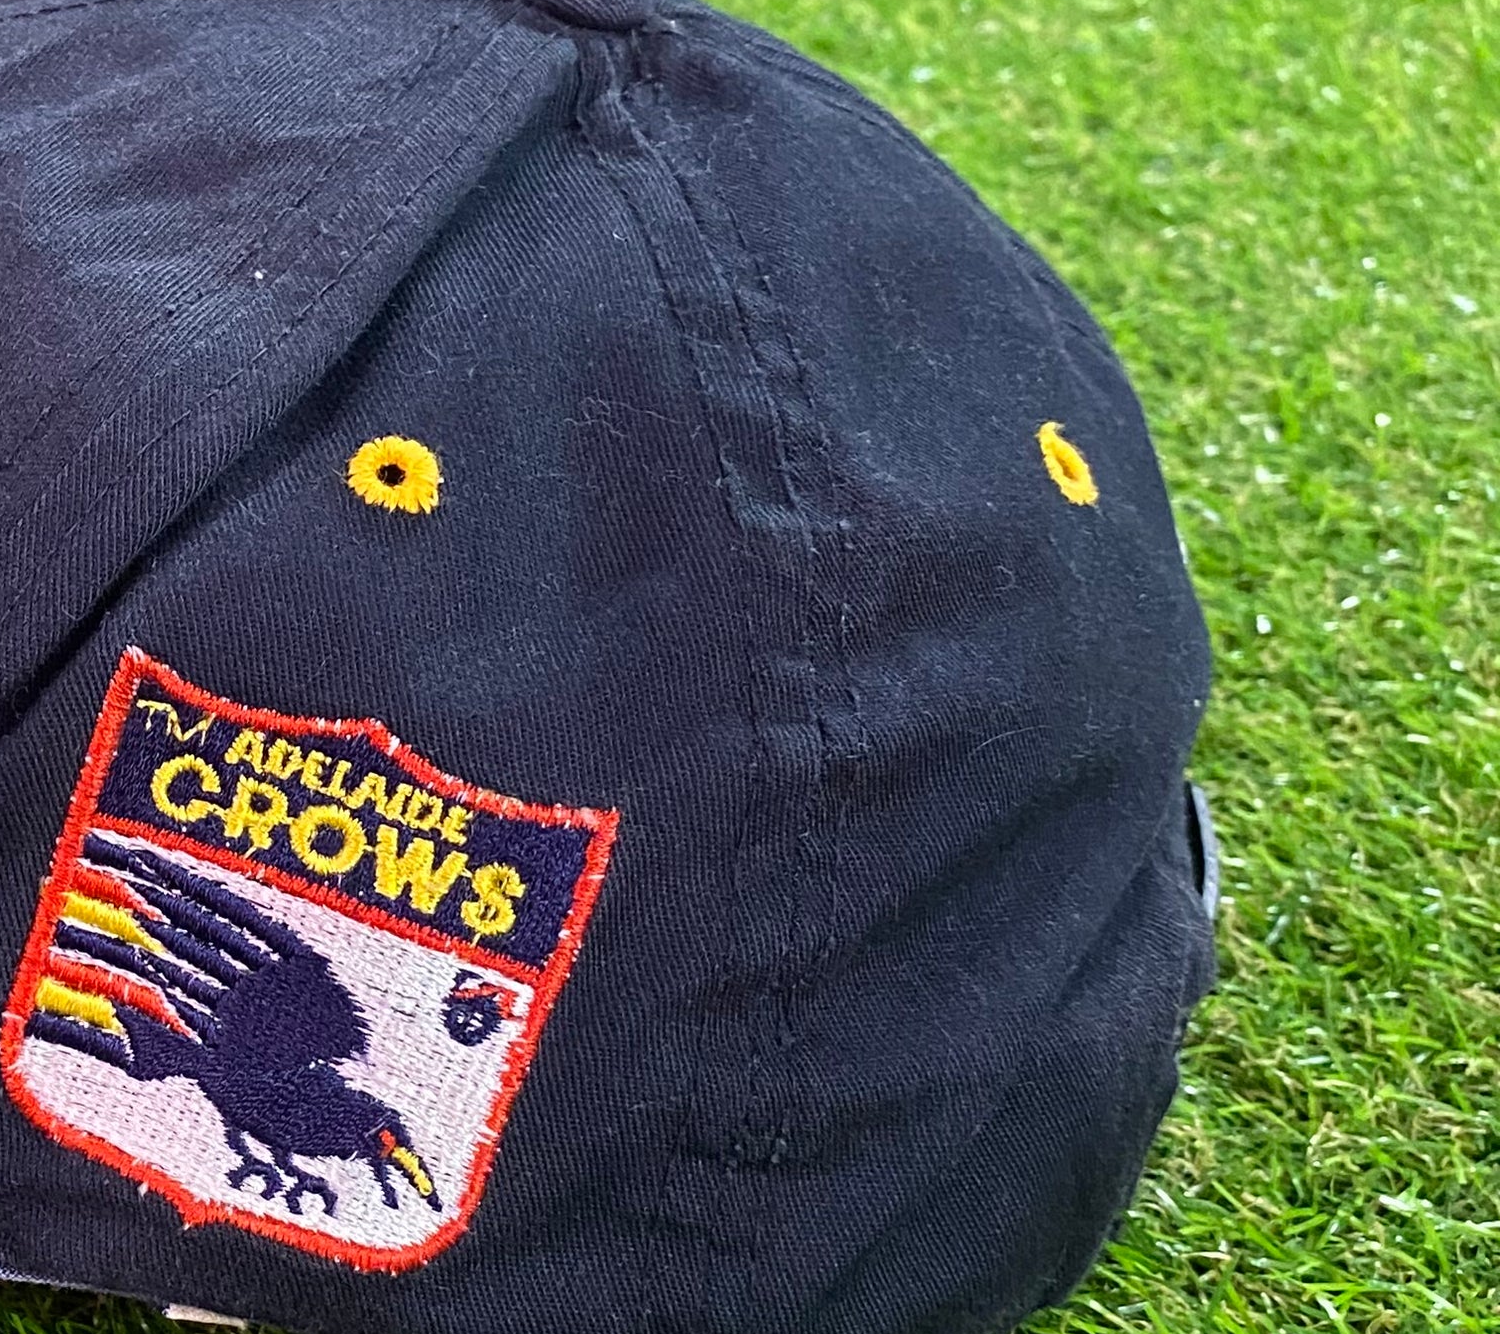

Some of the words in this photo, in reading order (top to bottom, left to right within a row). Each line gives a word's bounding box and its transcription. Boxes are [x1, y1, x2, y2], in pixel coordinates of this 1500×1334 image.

[135, 699, 216, 746] TM
[224, 728, 475, 845] ADELAIDE
[150, 753, 526, 943] CROWS
